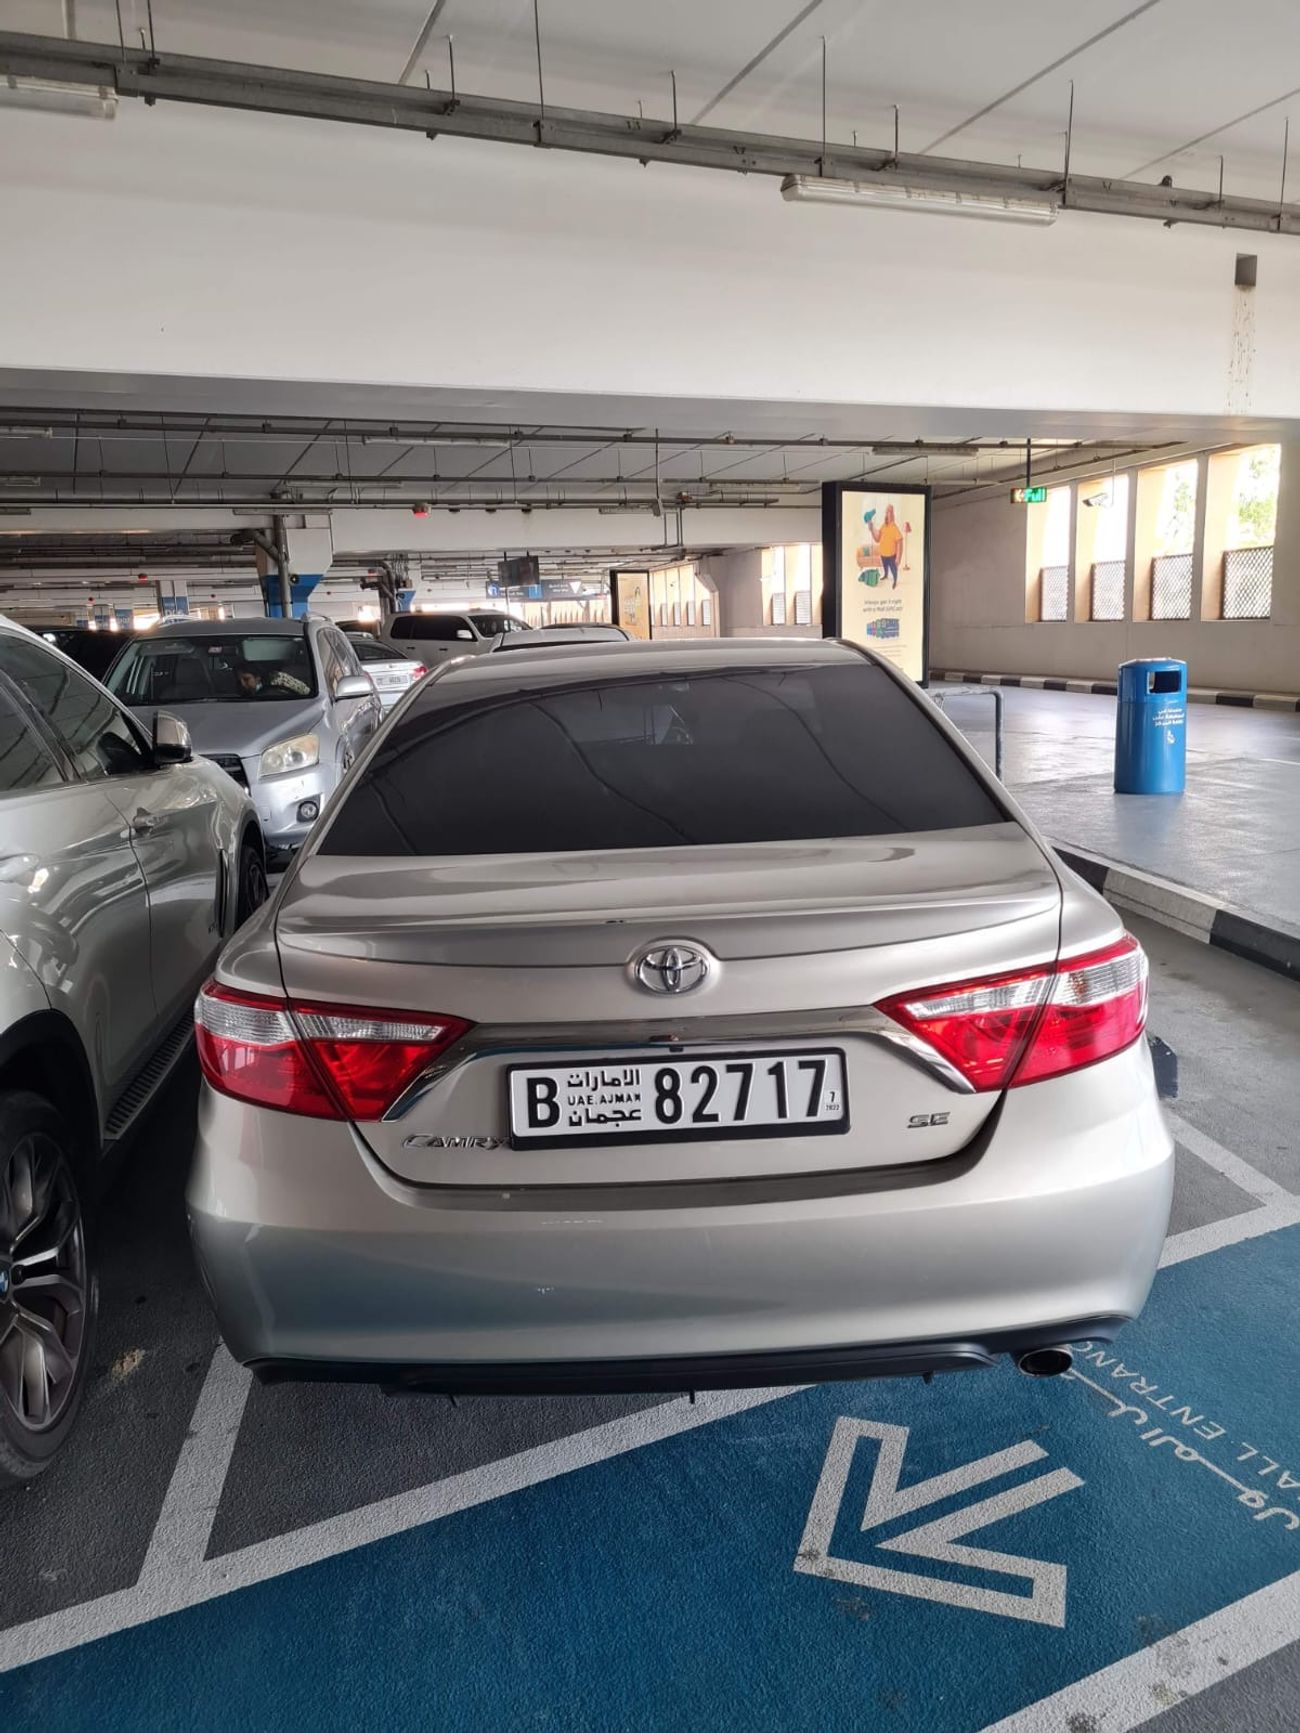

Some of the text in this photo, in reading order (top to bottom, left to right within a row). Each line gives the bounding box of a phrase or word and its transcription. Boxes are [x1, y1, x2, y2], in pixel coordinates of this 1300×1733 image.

[1024, 487, 1046, 503] Full
[567, 1069, 640, 1091] الامارات
[526, 1077, 560, 1128] B
[654, 1060, 827, 1125] 82717
[568, 1108, 642, 1128] عجمان
[906, 1111, 951, 1129] SE
[1070, 1340, 1300, 1493] ALL ENTRANC
